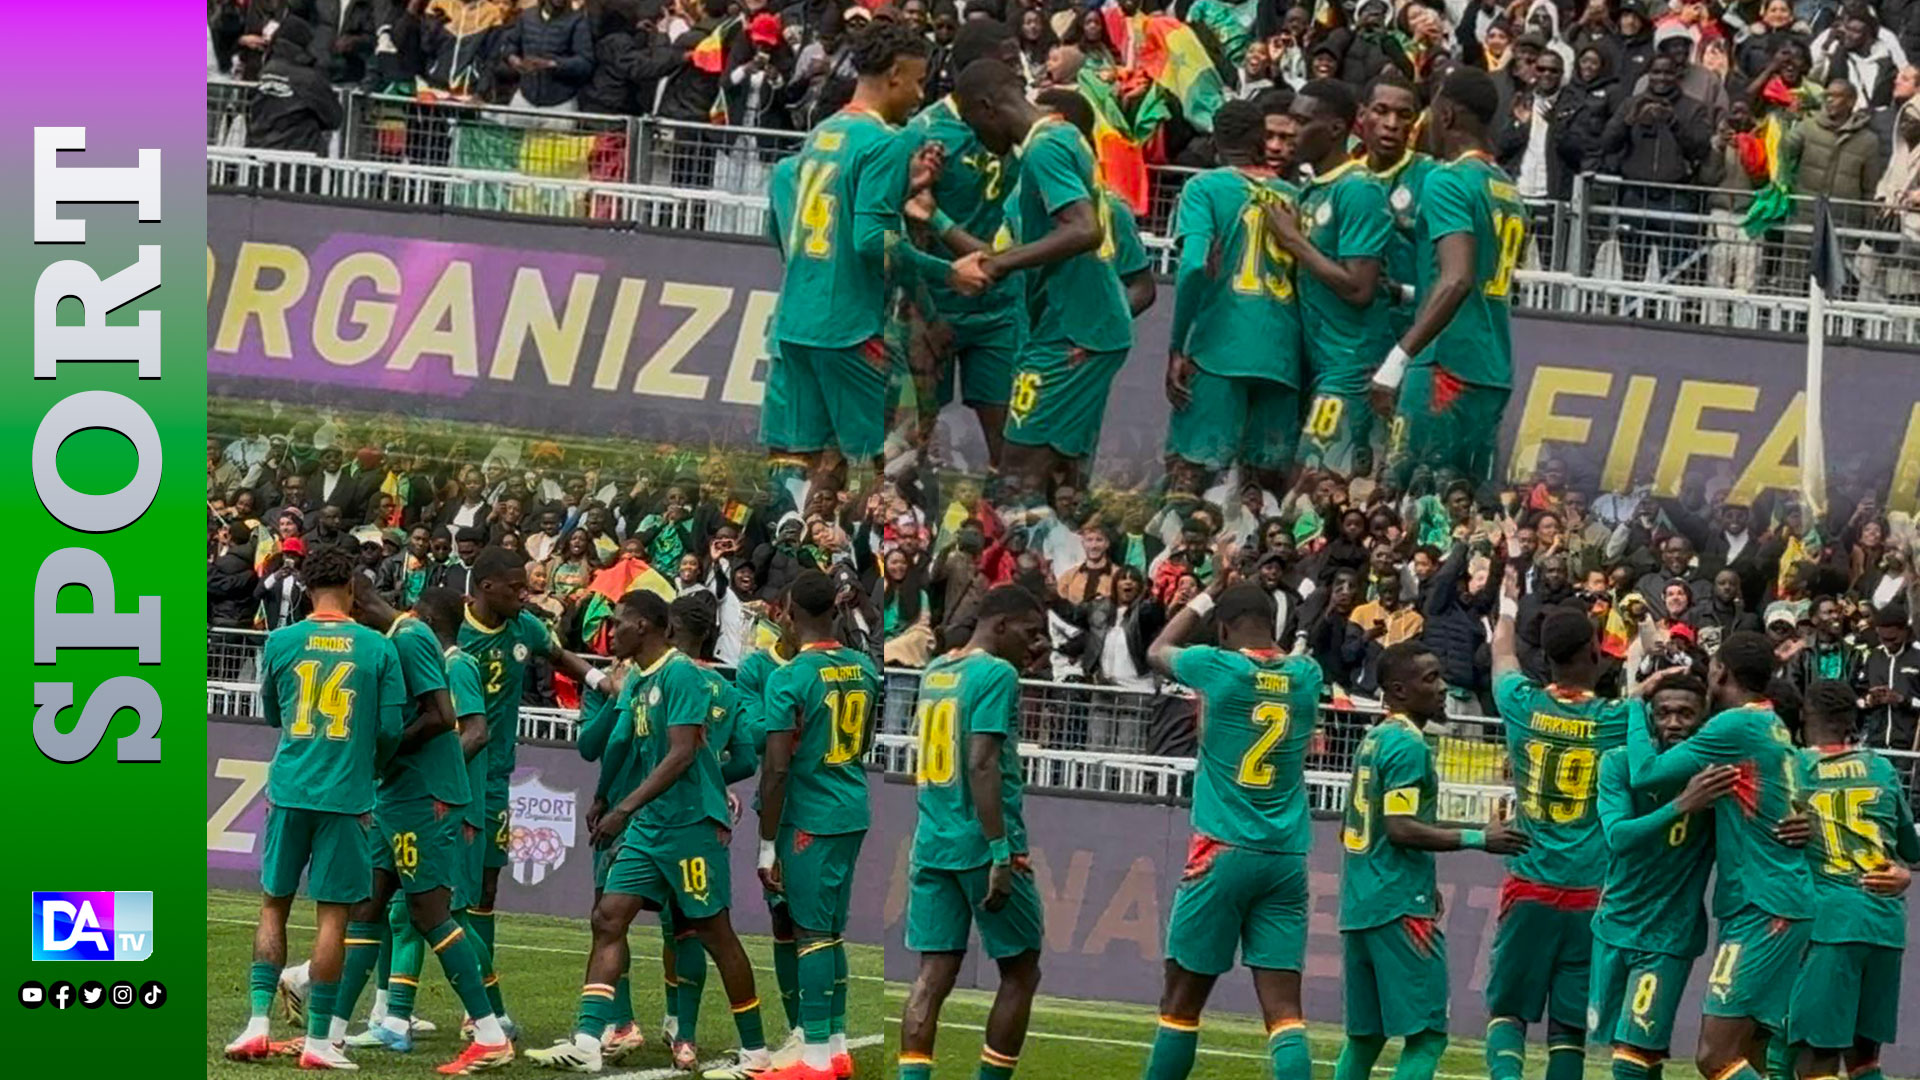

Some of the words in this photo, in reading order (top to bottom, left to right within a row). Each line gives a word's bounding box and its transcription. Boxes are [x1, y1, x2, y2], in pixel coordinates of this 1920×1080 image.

[207, 240, 783, 406] RGANIZE
[1303, 396, 1343, 437] 18
[1507, 365, 1812, 507] FIFA
[305, 635, 354, 653] JAKOBS
[291, 660, 357, 741] 14
[824, 689, 868, 766] 19
[917, 698, 959, 788] 18
[1237, 701, 1290, 789] 2
[1523, 740, 1599, 824] 19
[515, 796, 577, 817] SPORT
[1808, 786, 1884, 875] 15
[393, 832, 418, 867] 26
[679, 856, 707, 892] 18
[1632, 973, 1657, 1015] 8
